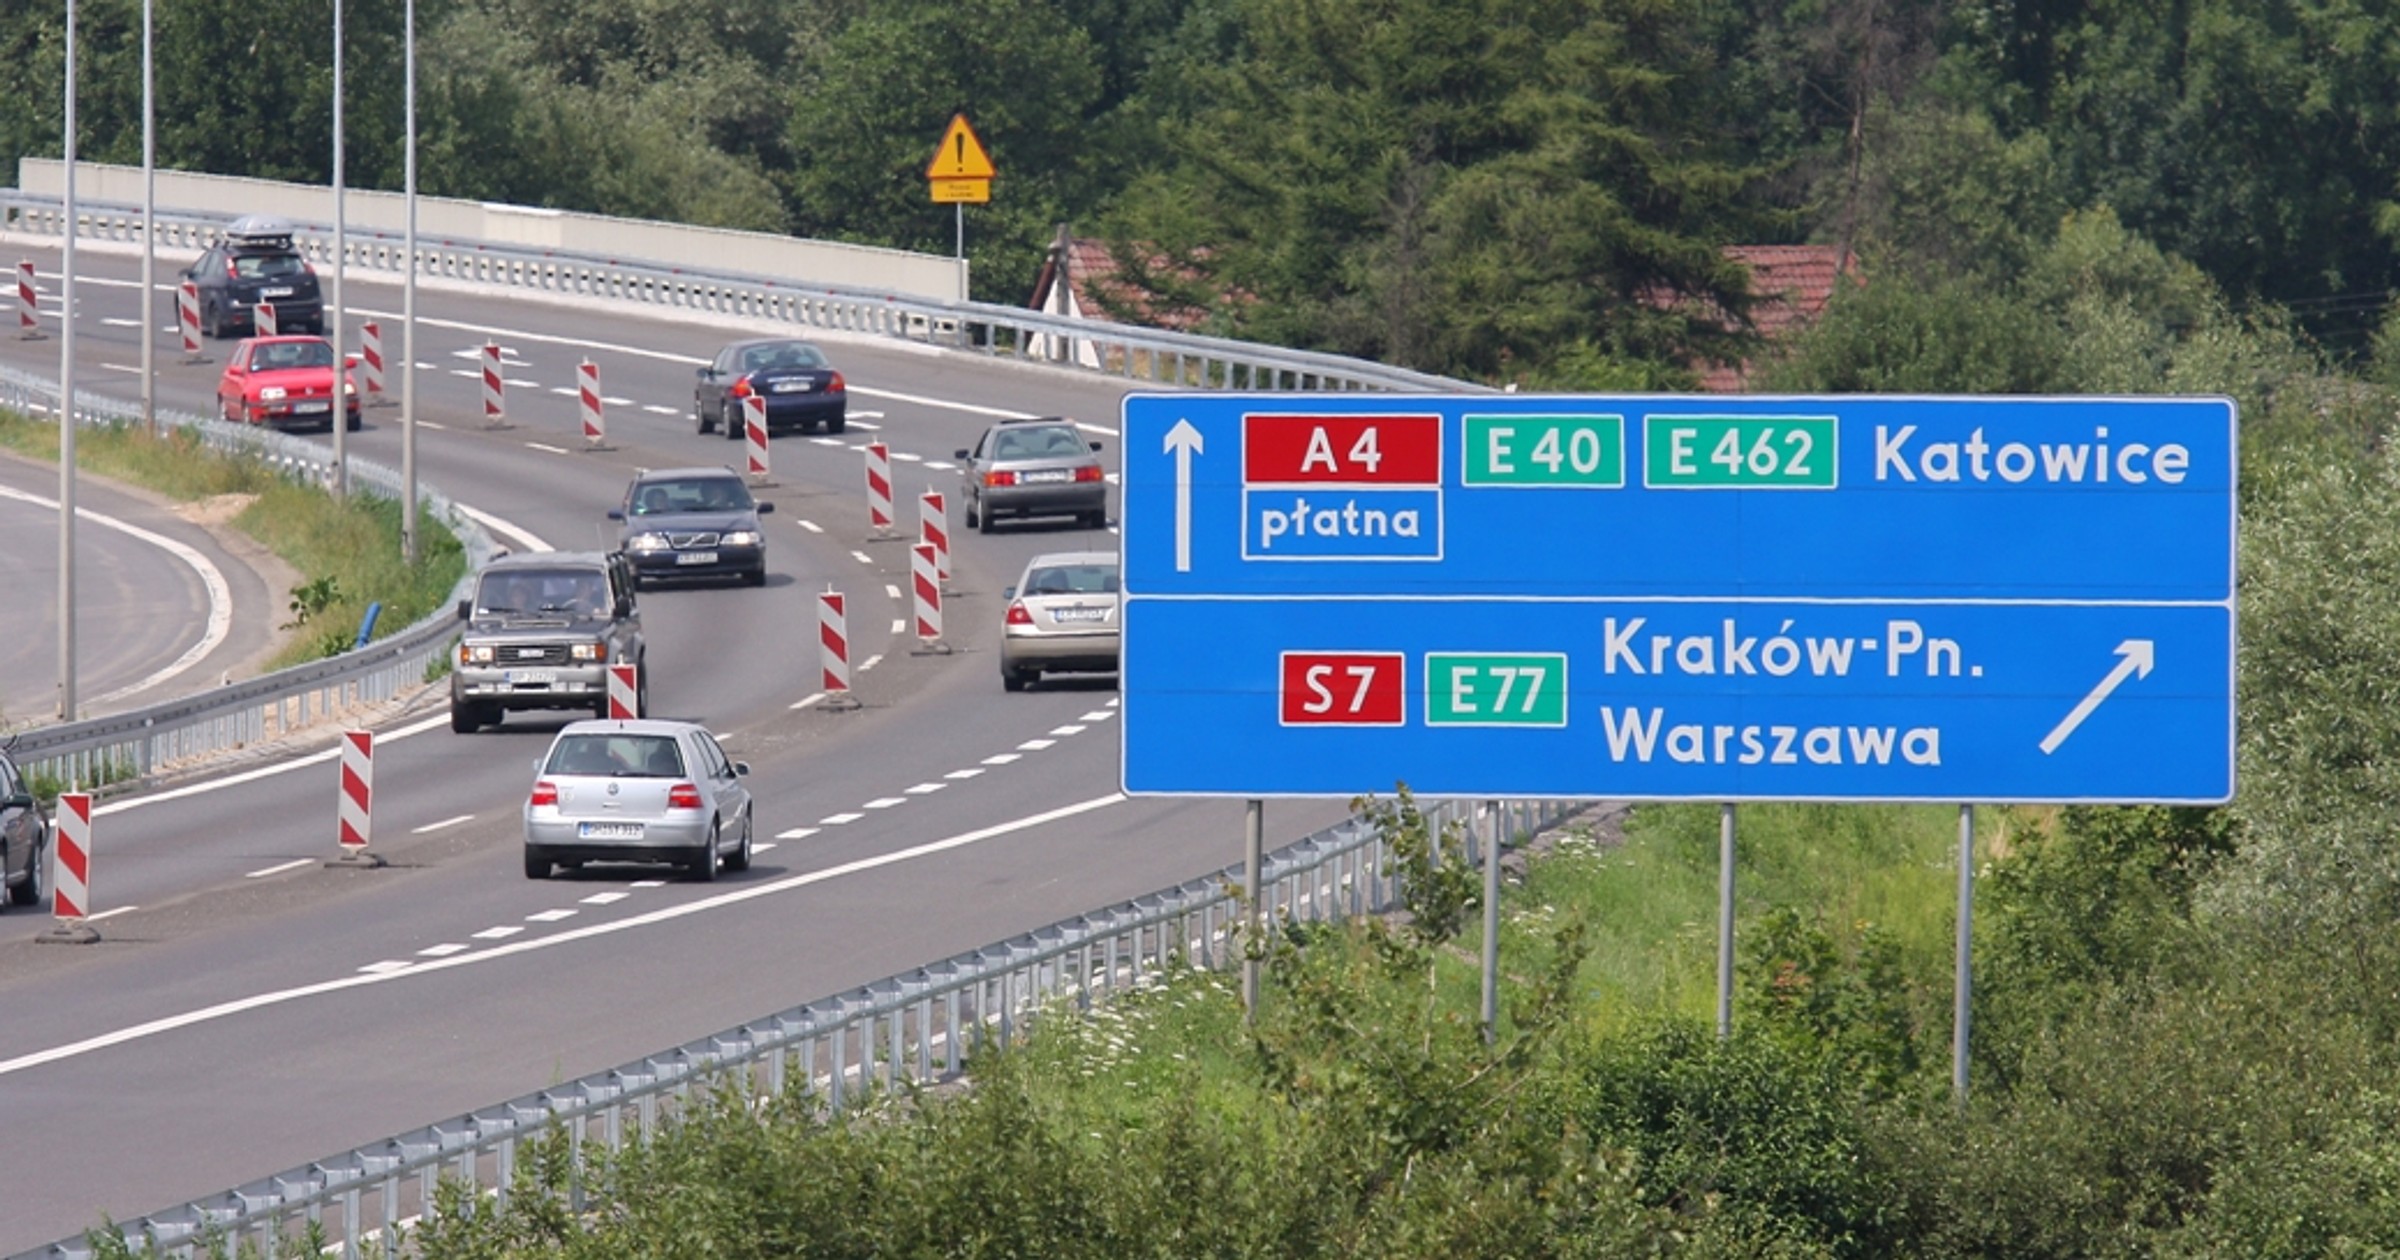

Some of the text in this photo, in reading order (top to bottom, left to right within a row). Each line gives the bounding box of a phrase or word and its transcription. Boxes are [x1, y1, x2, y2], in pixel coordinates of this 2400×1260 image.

[1875, 425, 2189, 484] Katowice
[1262, 498, 1419, 548] płatna
[1603, 617, 1984, 677] Kraków-Pn.
[1600, 706, 1941, 765] Warszawa
